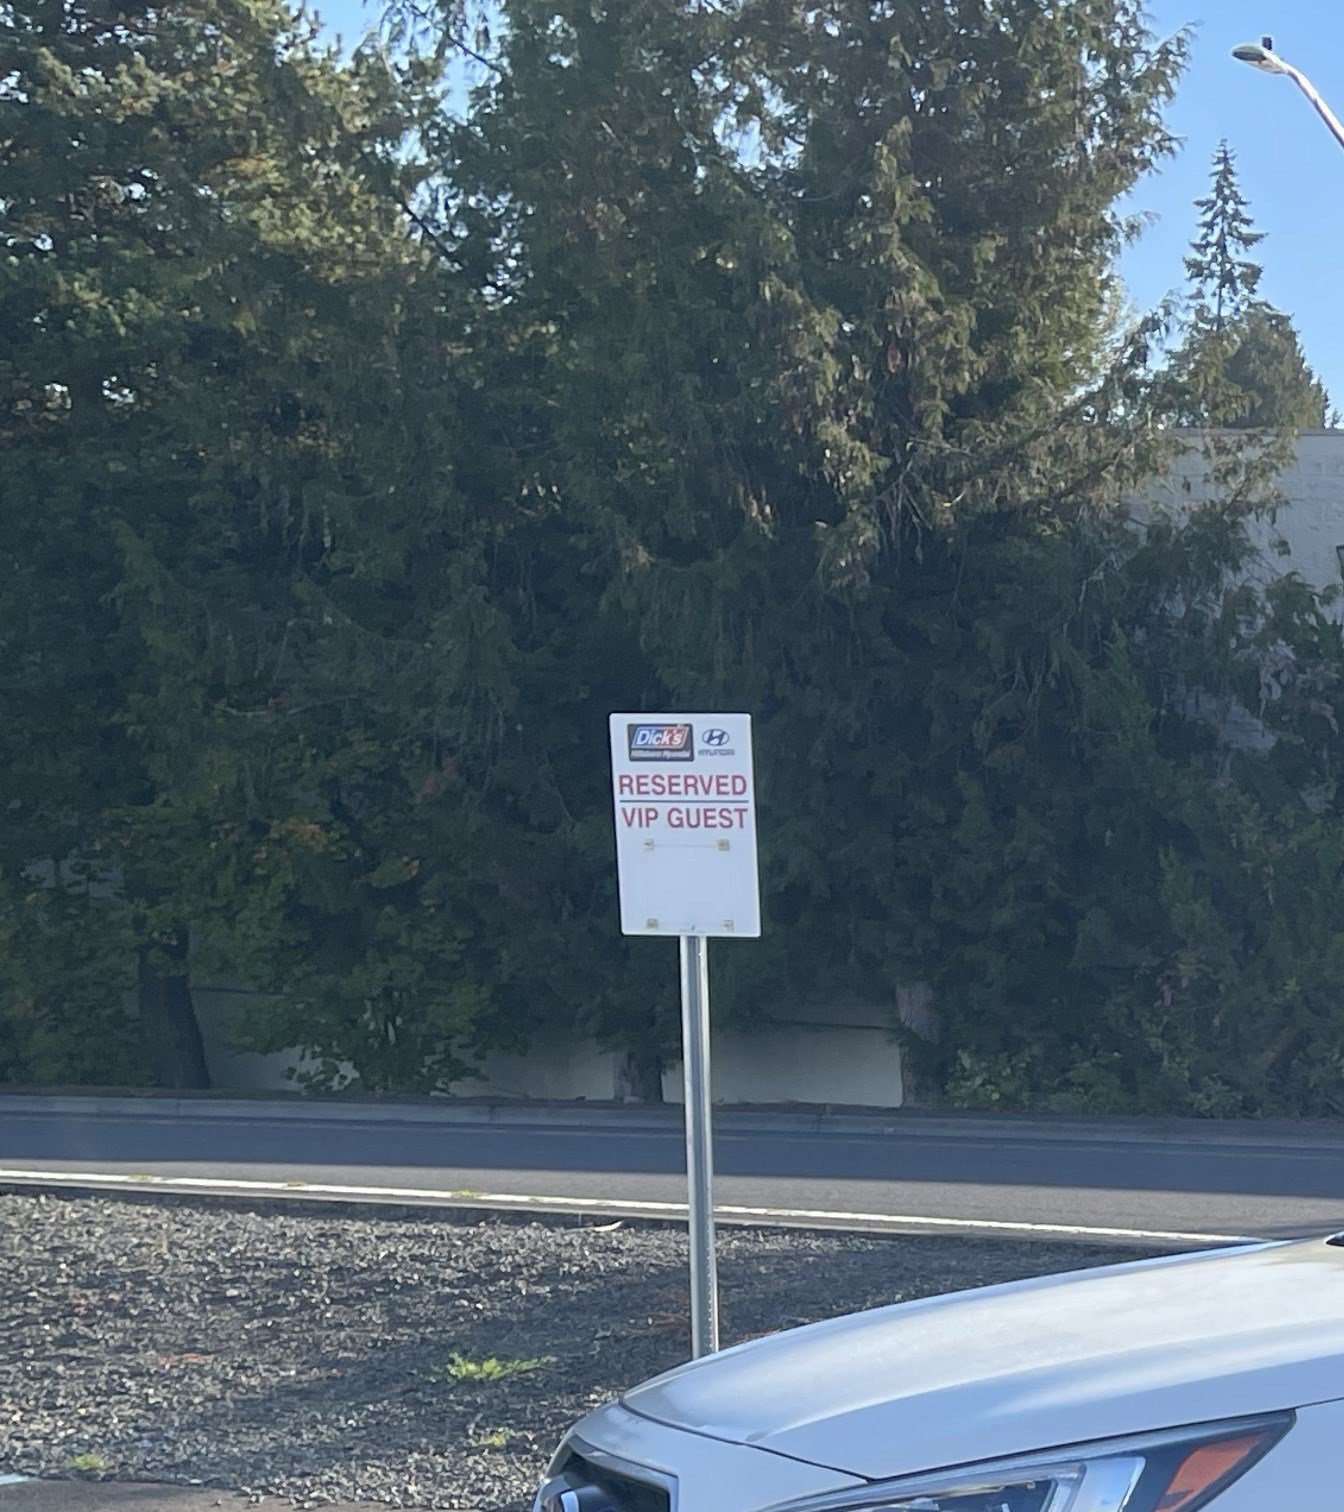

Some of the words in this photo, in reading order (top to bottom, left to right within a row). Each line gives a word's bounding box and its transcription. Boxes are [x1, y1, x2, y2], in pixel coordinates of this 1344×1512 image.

[618, 774, 748, 796] RESERVED
[621, 807, 659, 829] VIP
[667, 807, 749, 829] GUEST
